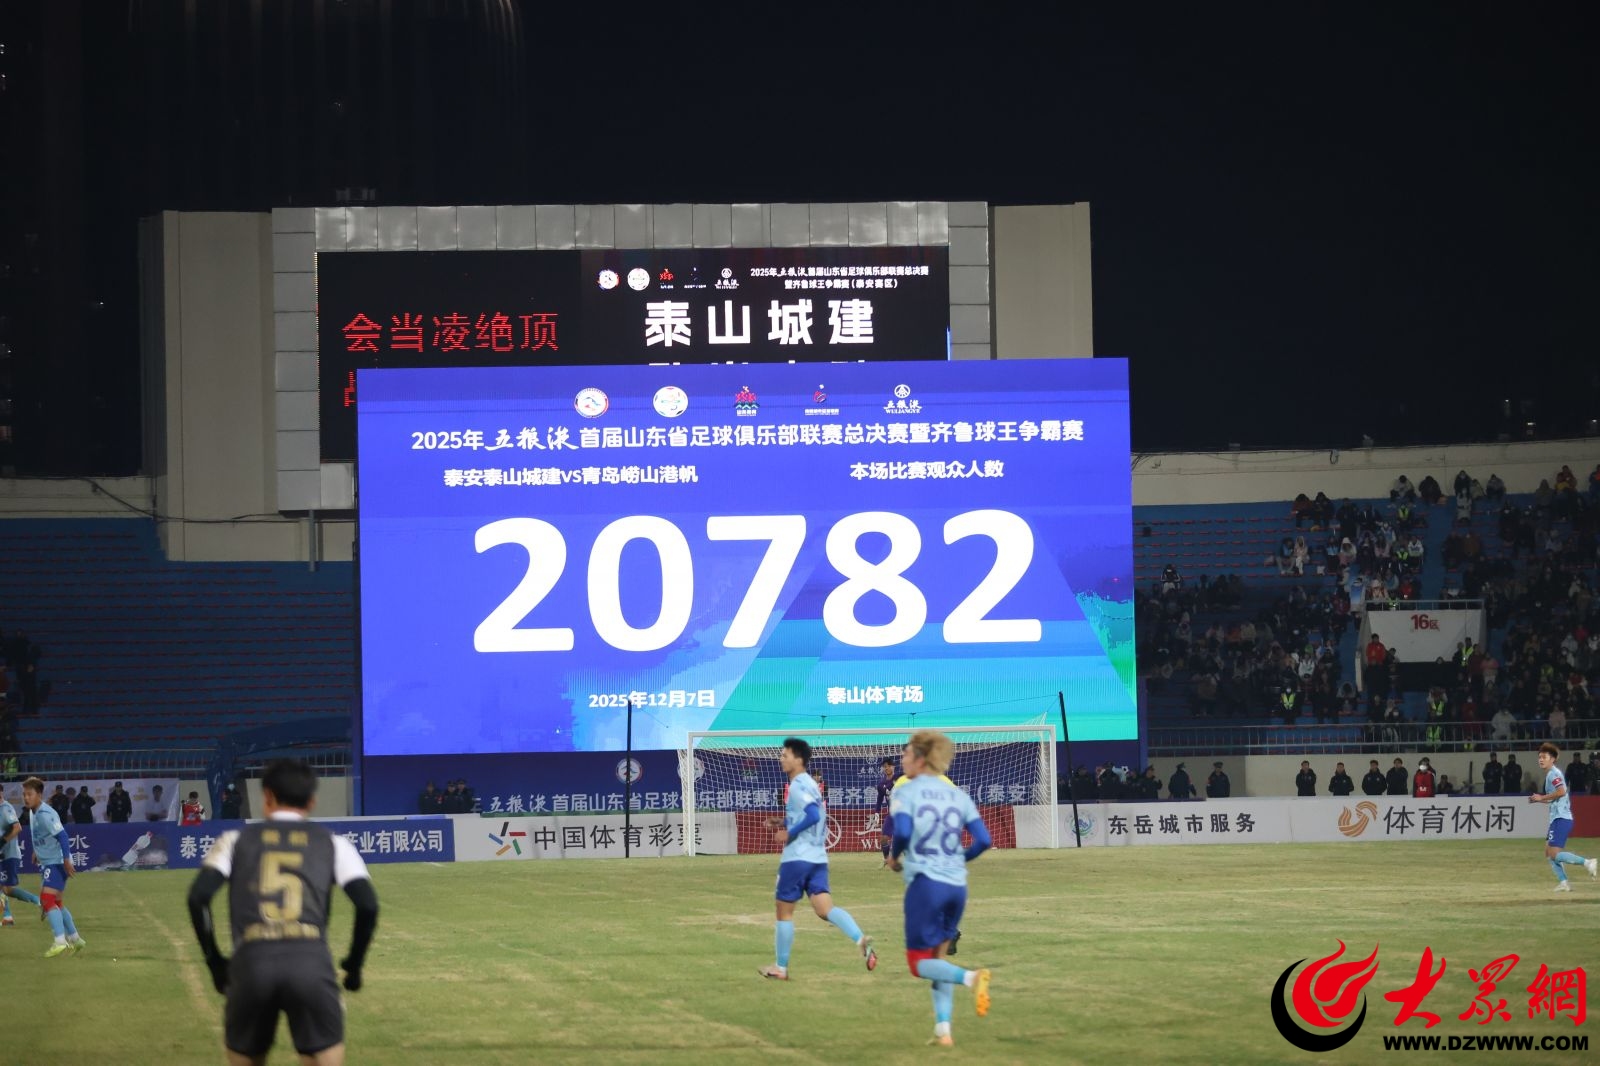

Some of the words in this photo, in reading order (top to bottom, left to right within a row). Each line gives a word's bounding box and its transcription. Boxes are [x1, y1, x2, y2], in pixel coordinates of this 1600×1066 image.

[341, 312, 558, 352] 会当凌绝顶
[645, 298, 874, 347] 泰山城建
[411, 419, 1084, 451] 2025年五粮液首届山东省足球俱乐部联赛总决赛暨齐鲁球王争霸赛
[850, 460, 1005, 480] 本场比赛观众人数
[473, 509, 1042, 653] 20782
[1411, 613, 1440, 631] 16区
[588, 689, 715, 709] 2025年12月7日
[827, 685, 924, 704] 泰山体育场
[915, 804, 962, 856] 28
[1108, 813, 1255, 835] 东岳城市服务
[1383, 805, 1515, 835] 体育休闲
[259, 850, 304, 921] 5
